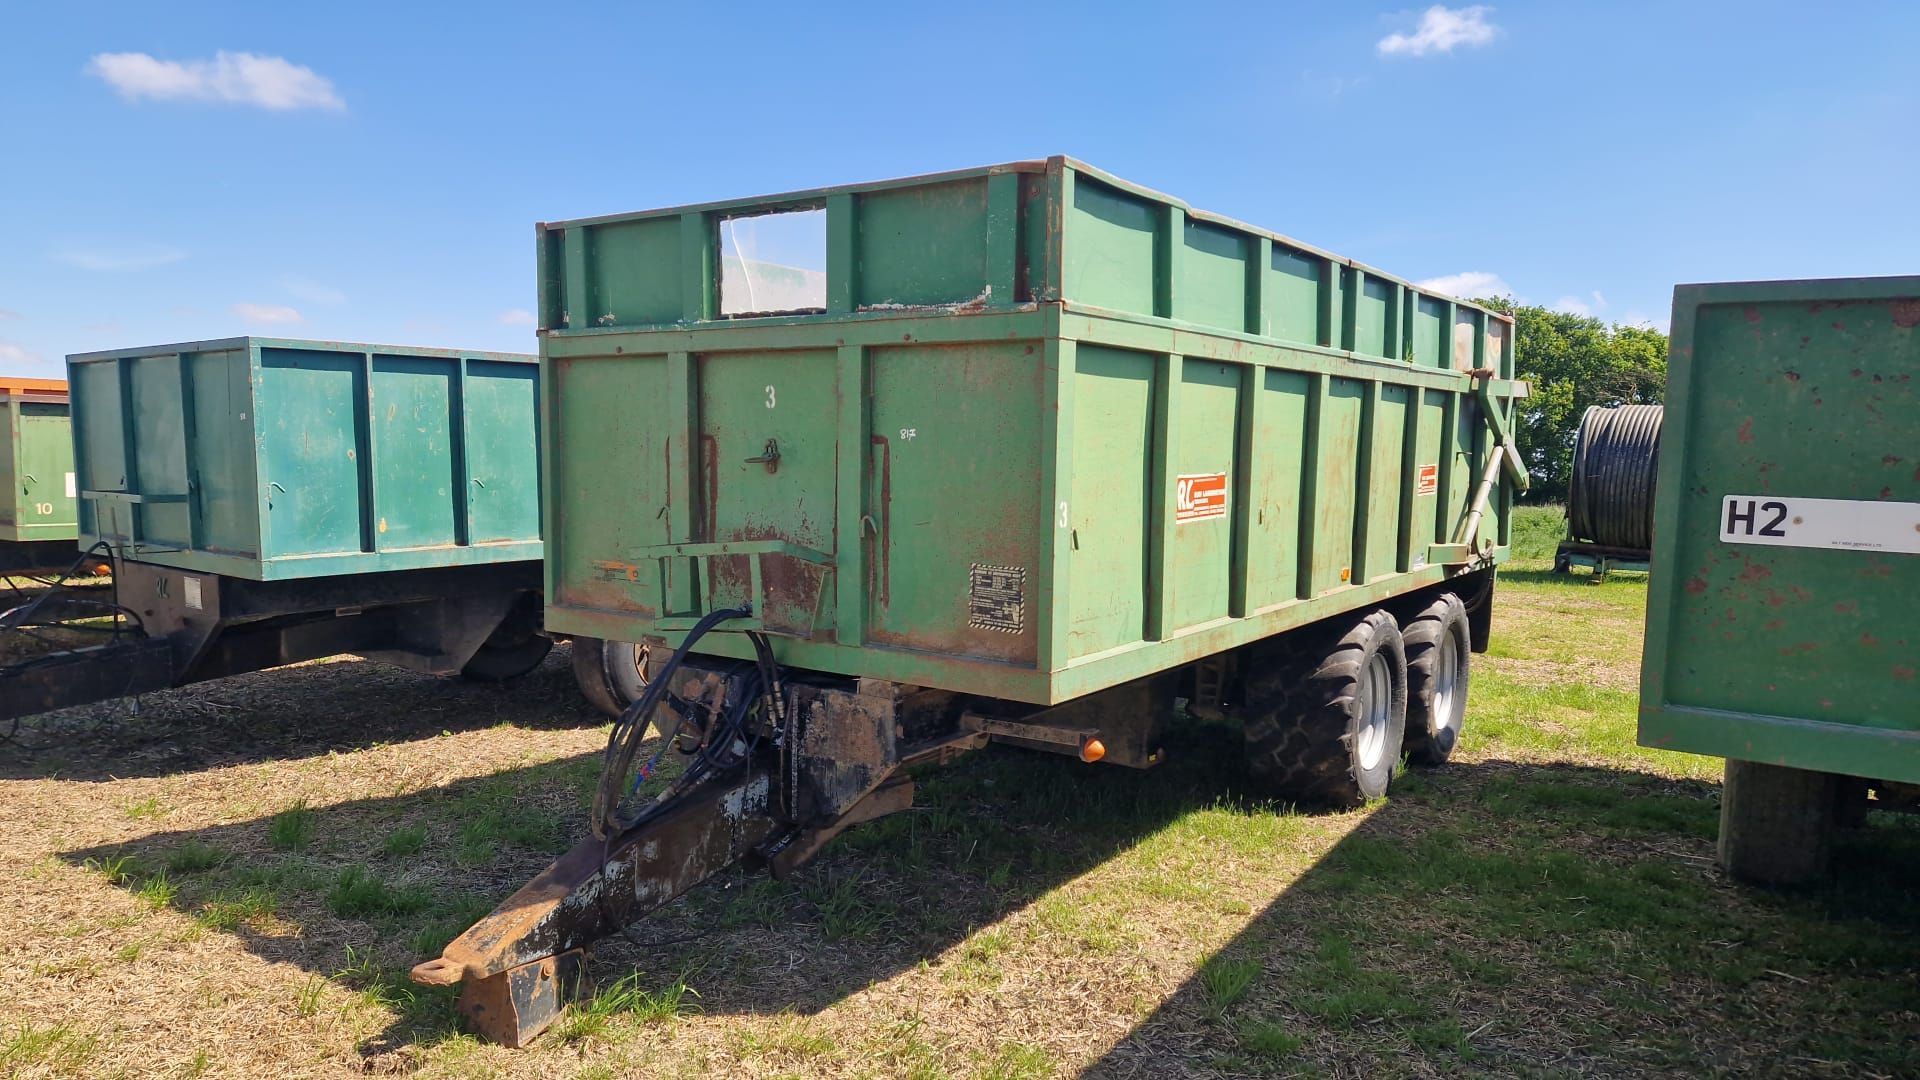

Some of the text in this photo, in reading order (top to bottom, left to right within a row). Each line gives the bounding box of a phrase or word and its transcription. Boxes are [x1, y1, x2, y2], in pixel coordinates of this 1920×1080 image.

[765, 384, 776, 409] 3
[900, 428, 916, 441] 817
[1177, 479, 1194, 511] RL
[36, 502, 53, 515] 10
[1060, 501, 1068, 528] 3
[1727, 500, 1788, 538] H2
